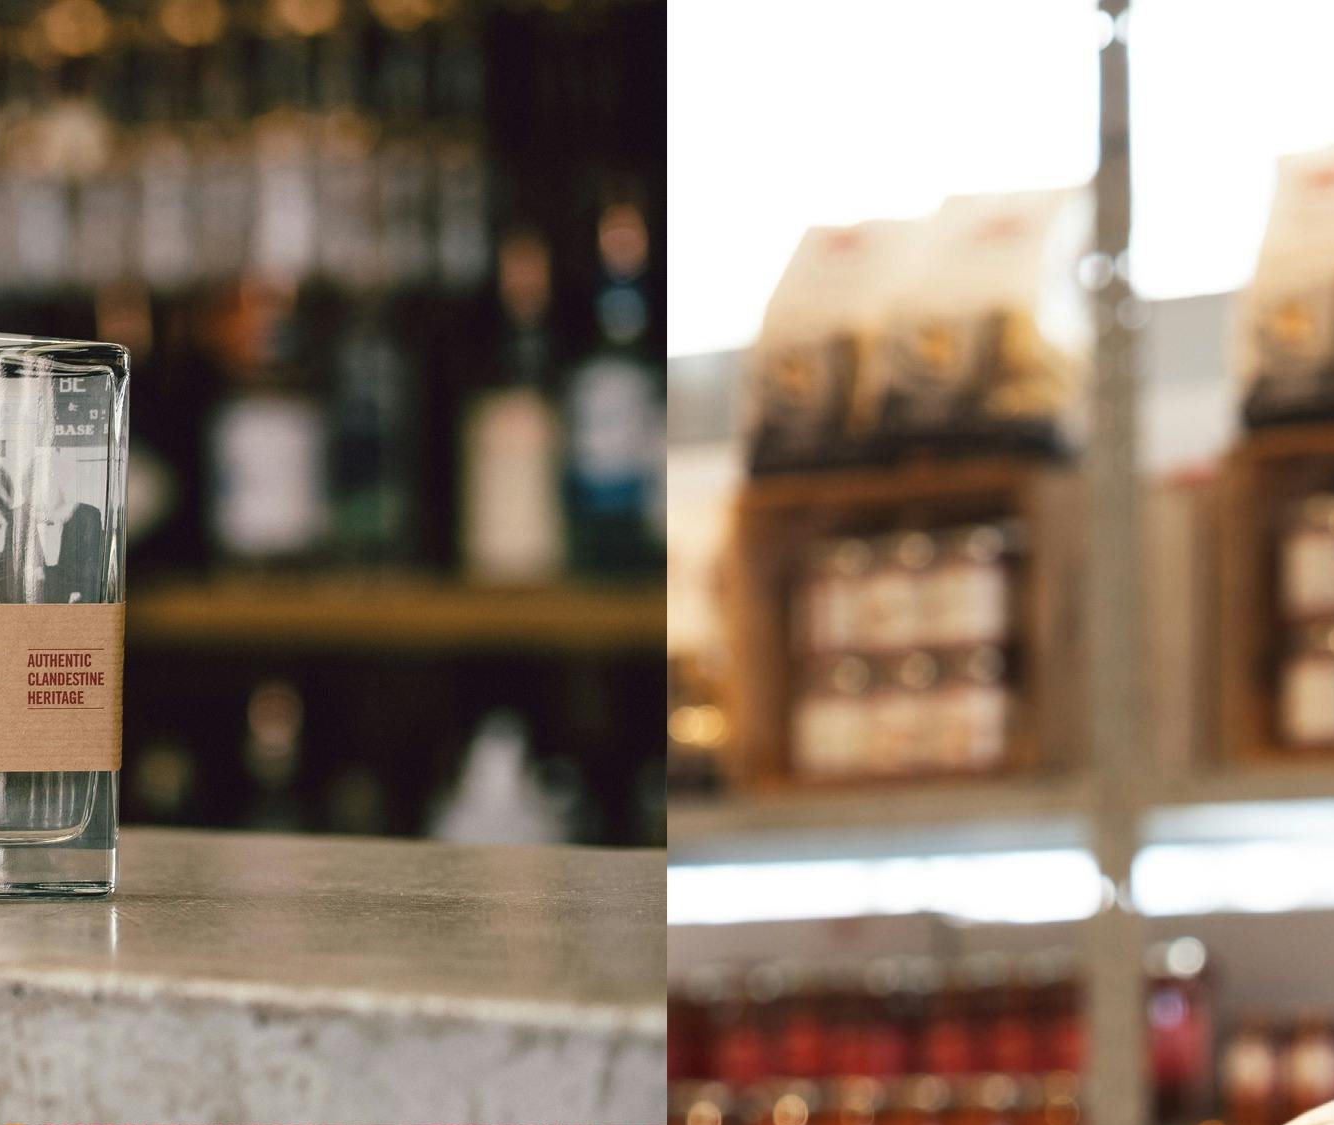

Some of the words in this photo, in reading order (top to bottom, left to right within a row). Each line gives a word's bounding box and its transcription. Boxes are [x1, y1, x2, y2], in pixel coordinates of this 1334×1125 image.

[27, 653, 92, 668] AUTHENTIC
[27, 672, 105, 686] CLANDESTINE
[27, 690, 85, 705] HERITAGE
